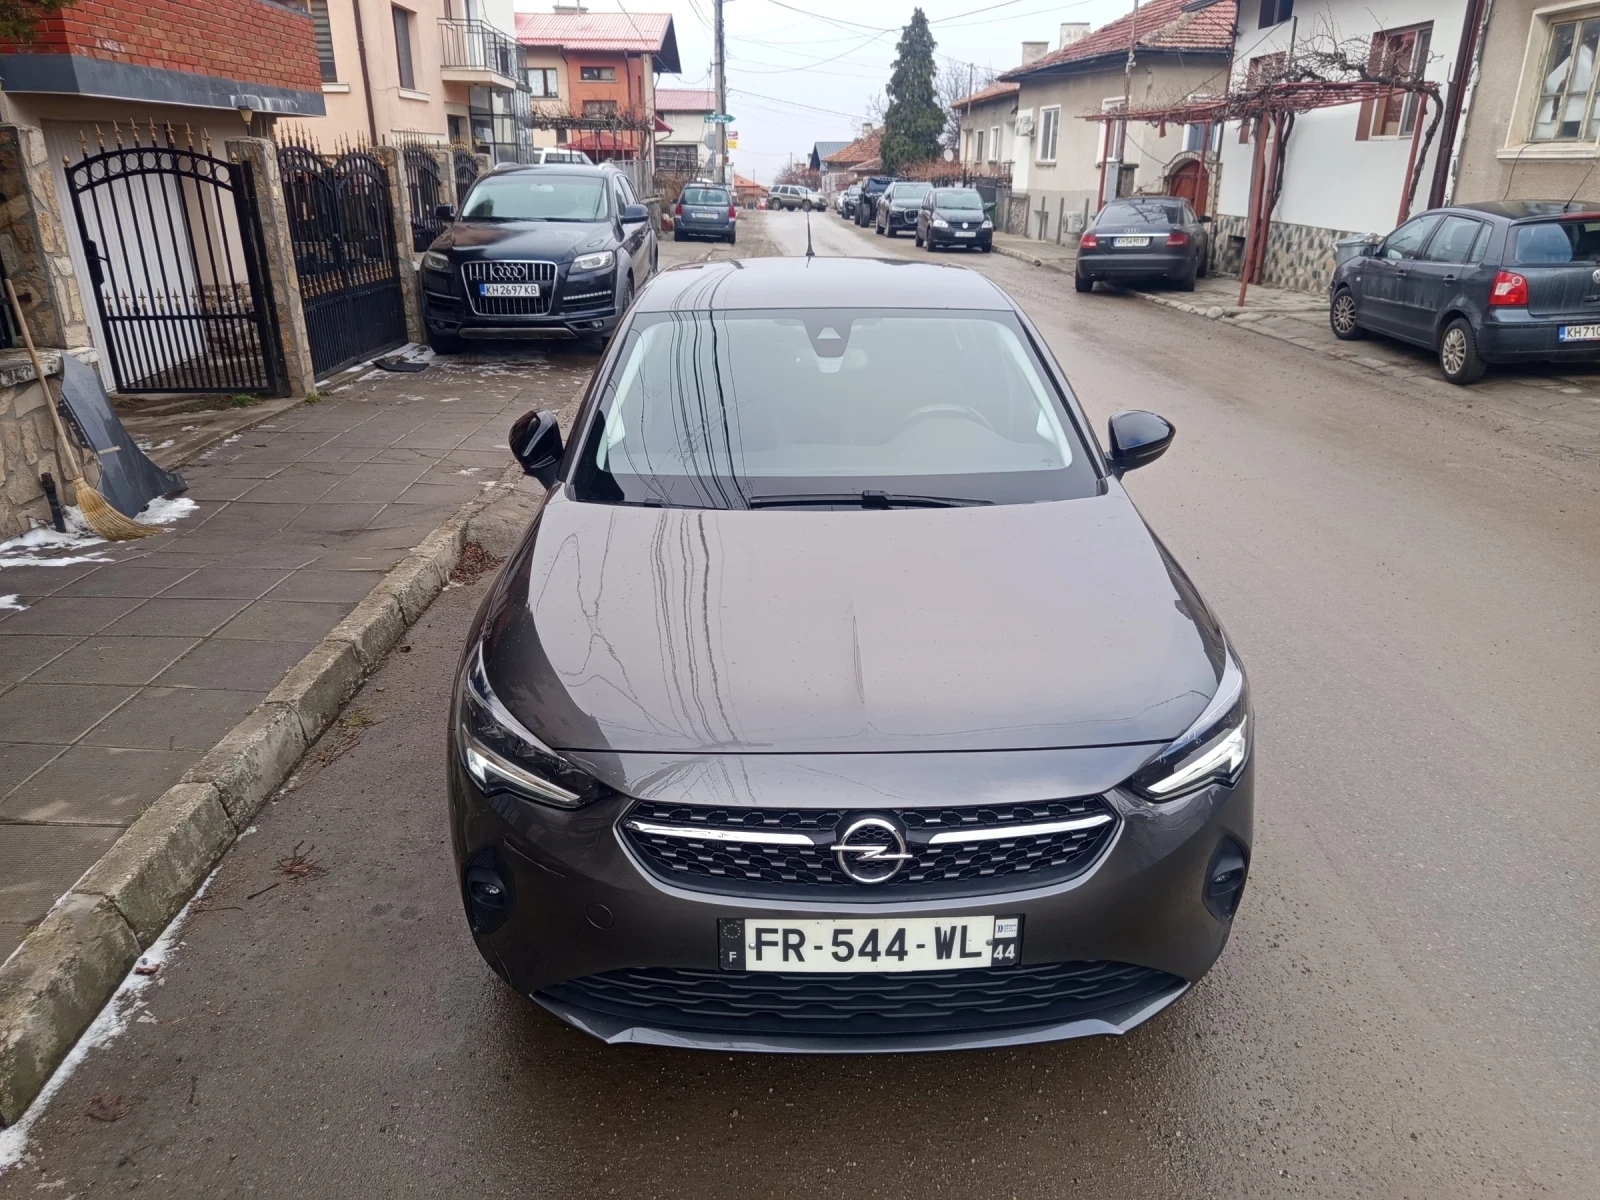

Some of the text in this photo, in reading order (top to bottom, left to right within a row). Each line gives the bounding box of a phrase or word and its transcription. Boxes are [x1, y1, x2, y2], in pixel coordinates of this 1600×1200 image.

[755, 925, 983, 962] FR-544-WL
[729, 951, 737, 962] F
[993, 944, 1015, 960] 44
